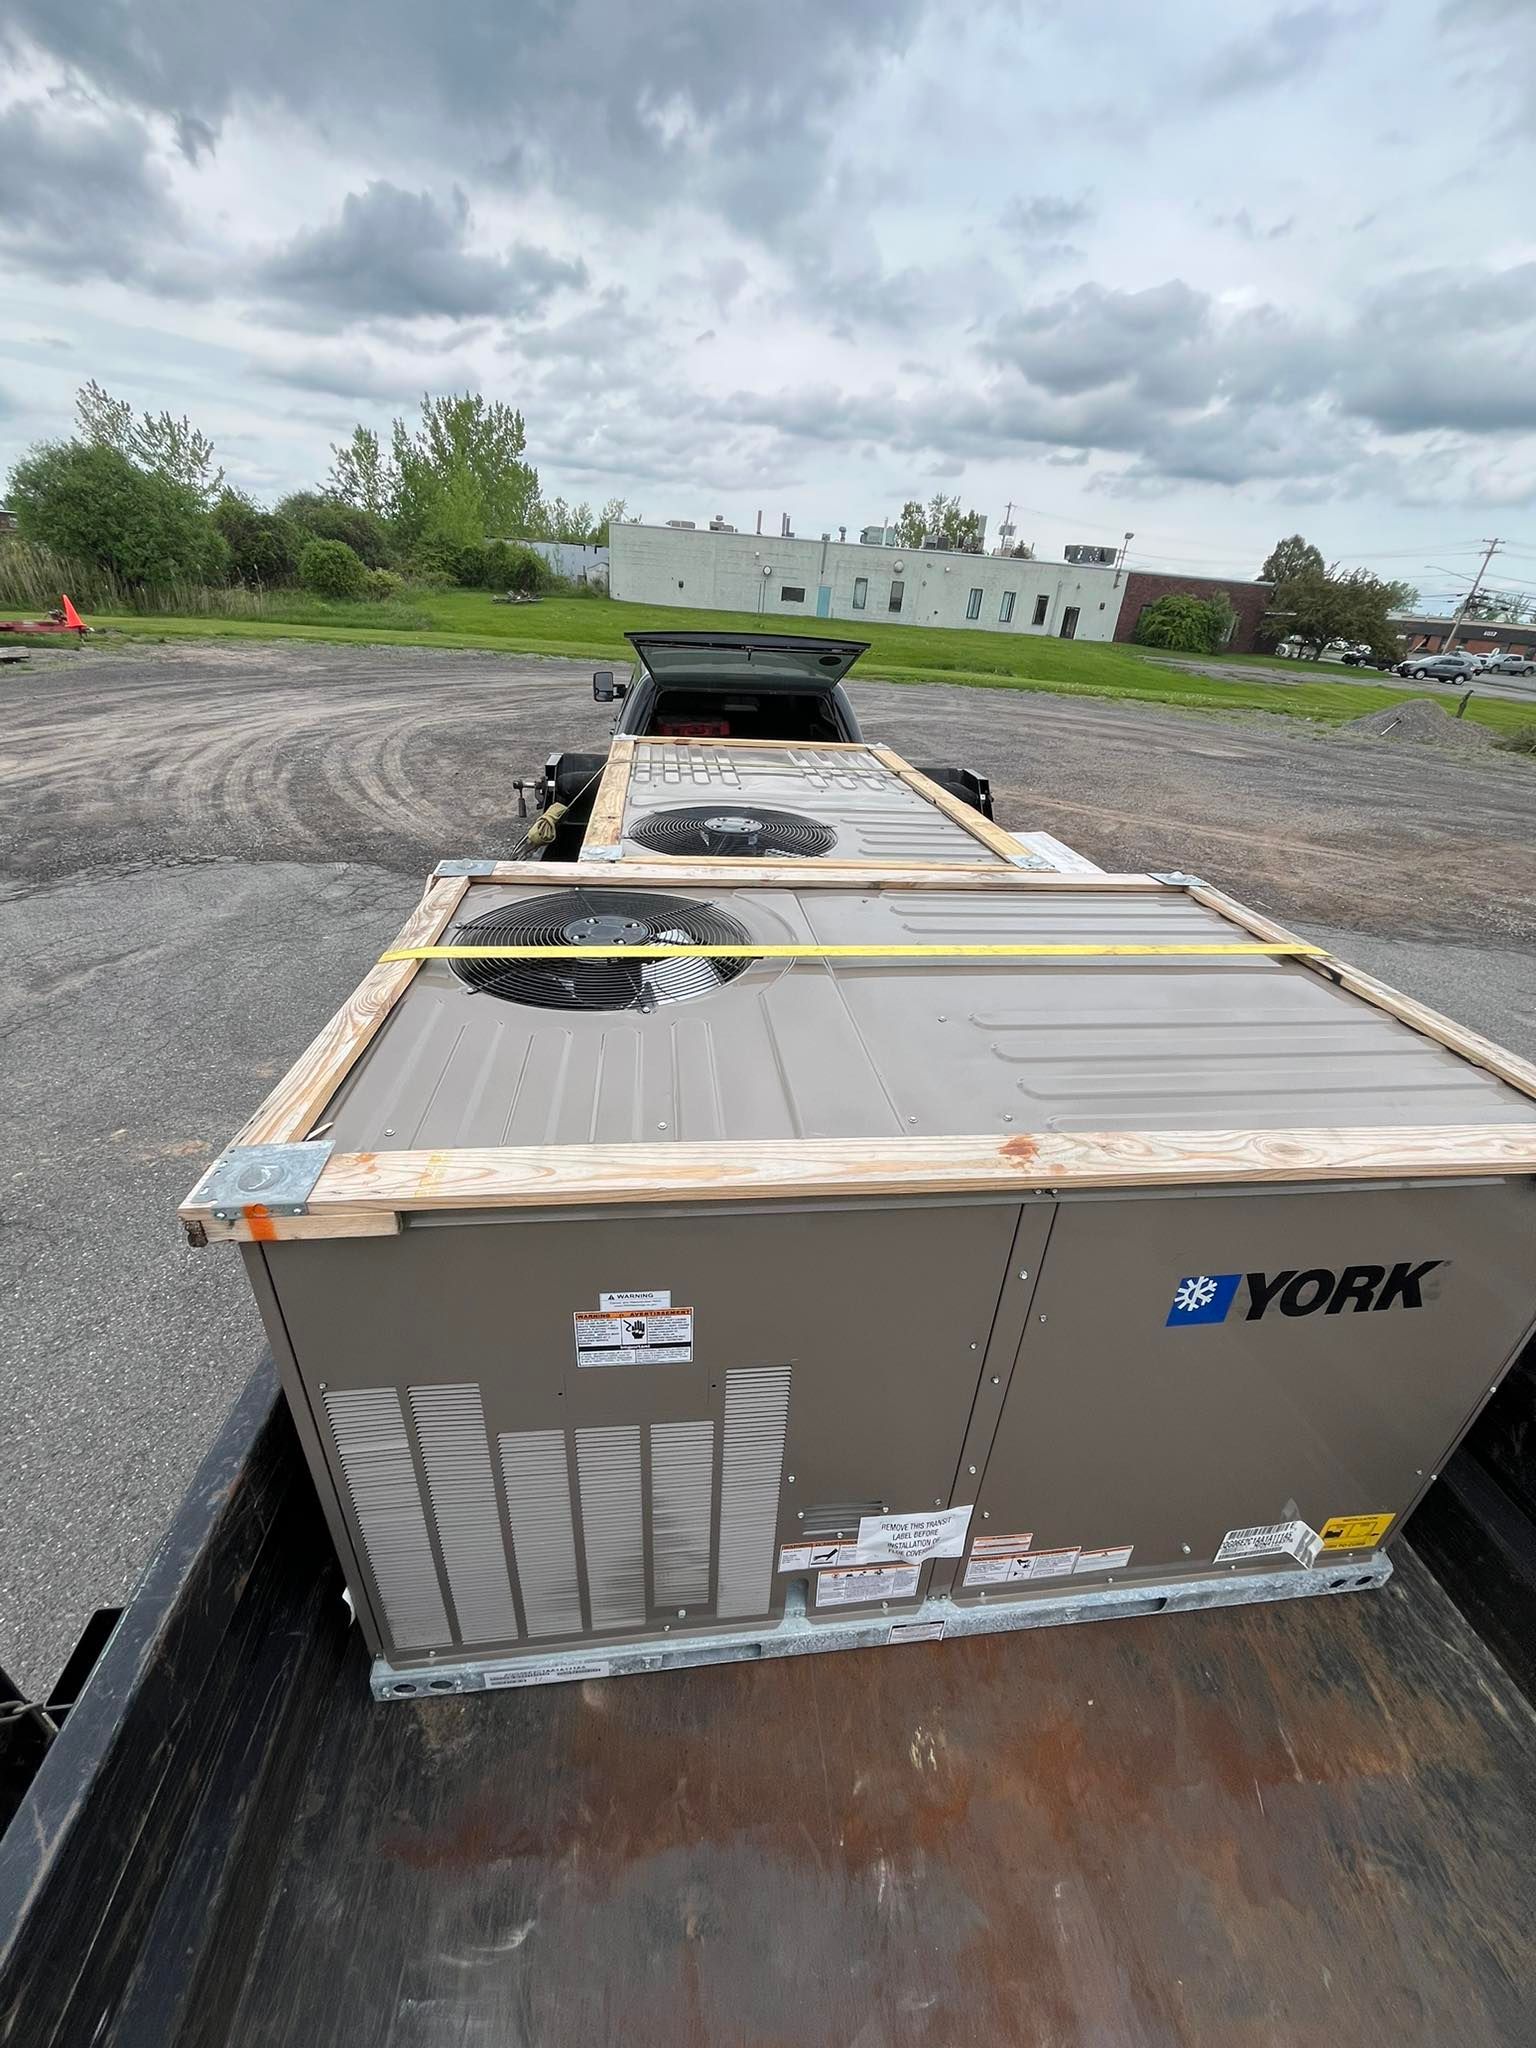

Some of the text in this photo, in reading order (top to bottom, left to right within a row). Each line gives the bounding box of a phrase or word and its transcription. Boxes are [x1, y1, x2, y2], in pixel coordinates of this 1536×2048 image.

[1246, 1260, 1444, 1321] YORK
[881, 1523, 909, 1531] REMOVE
[910, 1522, 925, 1530] THIS
[892, 1529, 939, 1541] LABEL BEFORE
[887, 1539, 932, 1549] INSTALLATION
